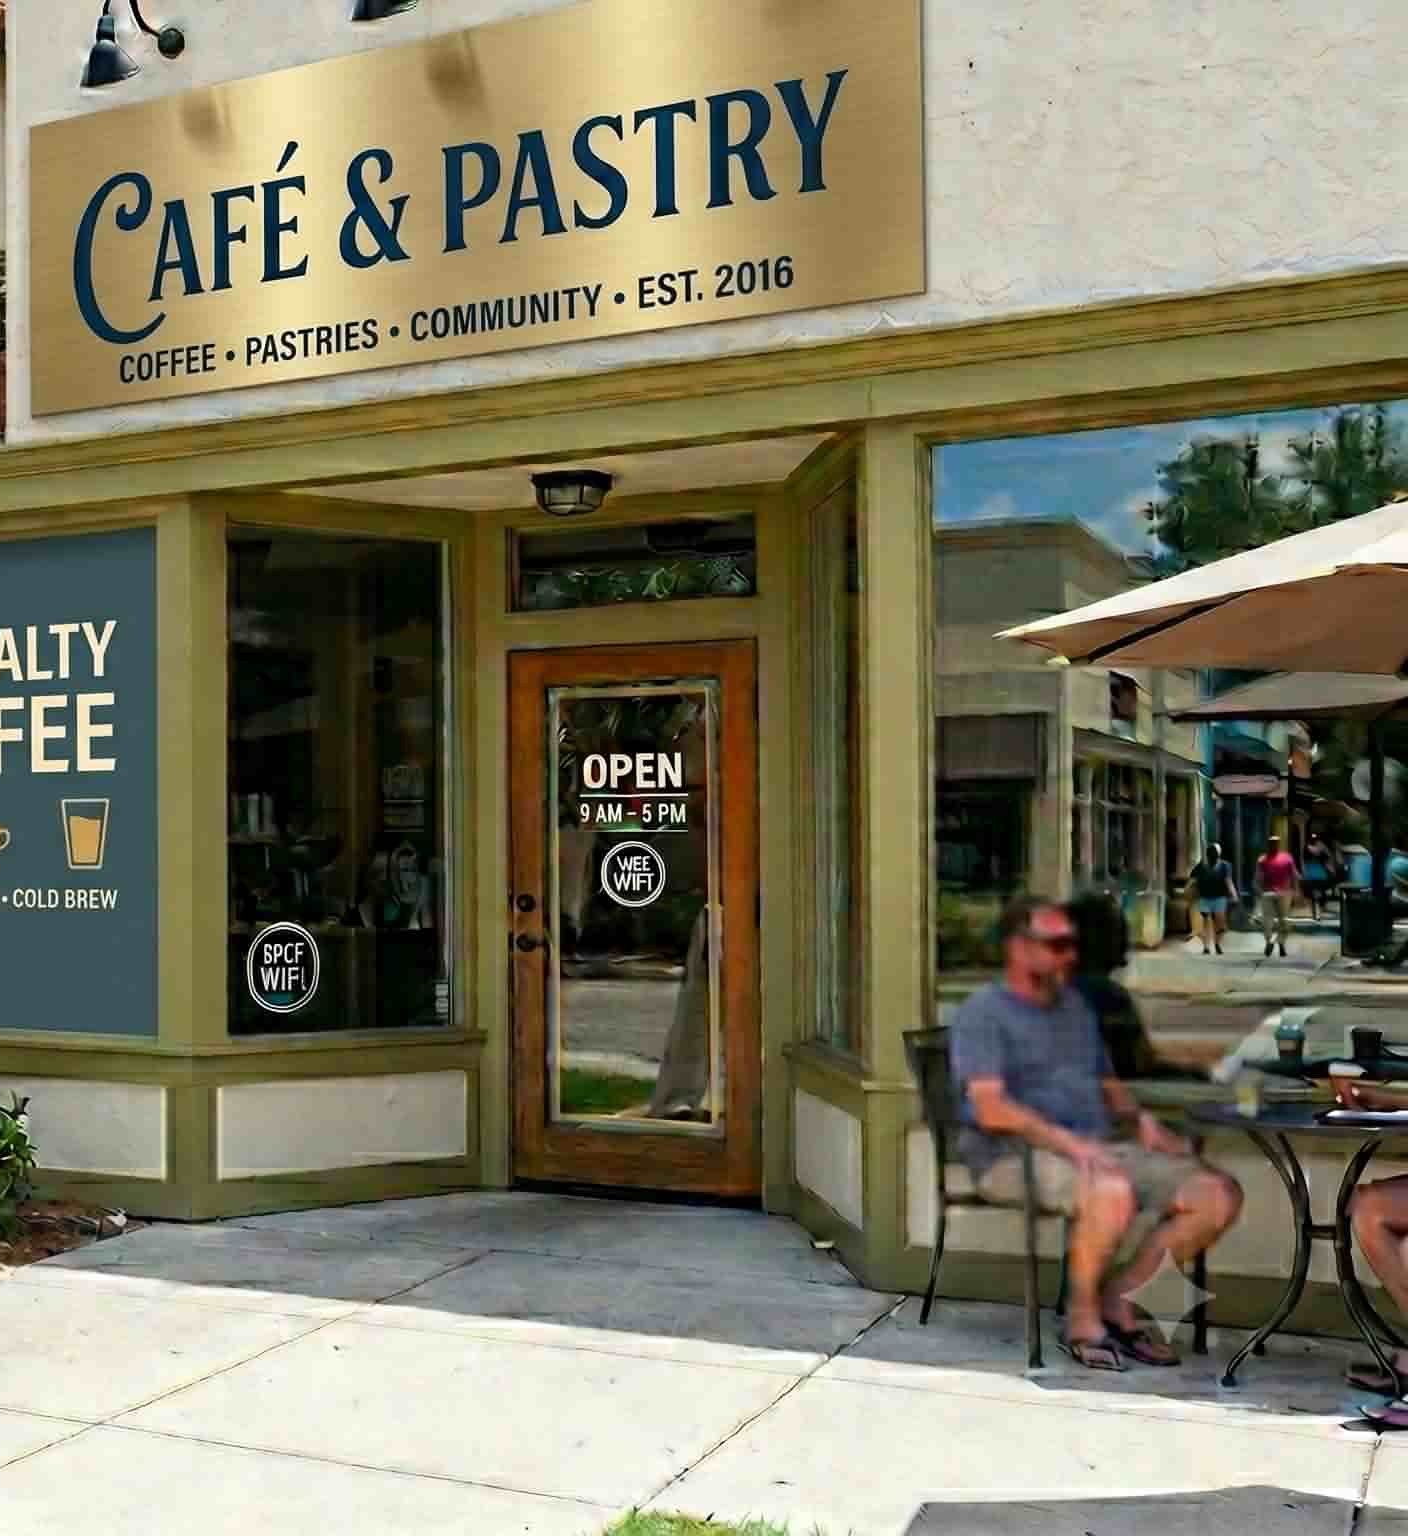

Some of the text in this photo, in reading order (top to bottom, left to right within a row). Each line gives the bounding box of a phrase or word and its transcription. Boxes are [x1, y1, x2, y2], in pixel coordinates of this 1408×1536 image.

[73, 69, 849, 345] CAFÉ & PASTRY
[120, 256, 795, 385] COFFEE PASTRIES COMMUNITY EST. 2016
[583, 752, 683, 789] OPEN
[580, 803, 590, 823] 9
[595, 803, 623, 823] AM
[642, 803, 652, 823] 5
[658, 803, 686, 823] PM
[616, 855, 651, 872] WEE
[12, 888, 59, 909] COLD
[64, 888, 118, 910] BREW
